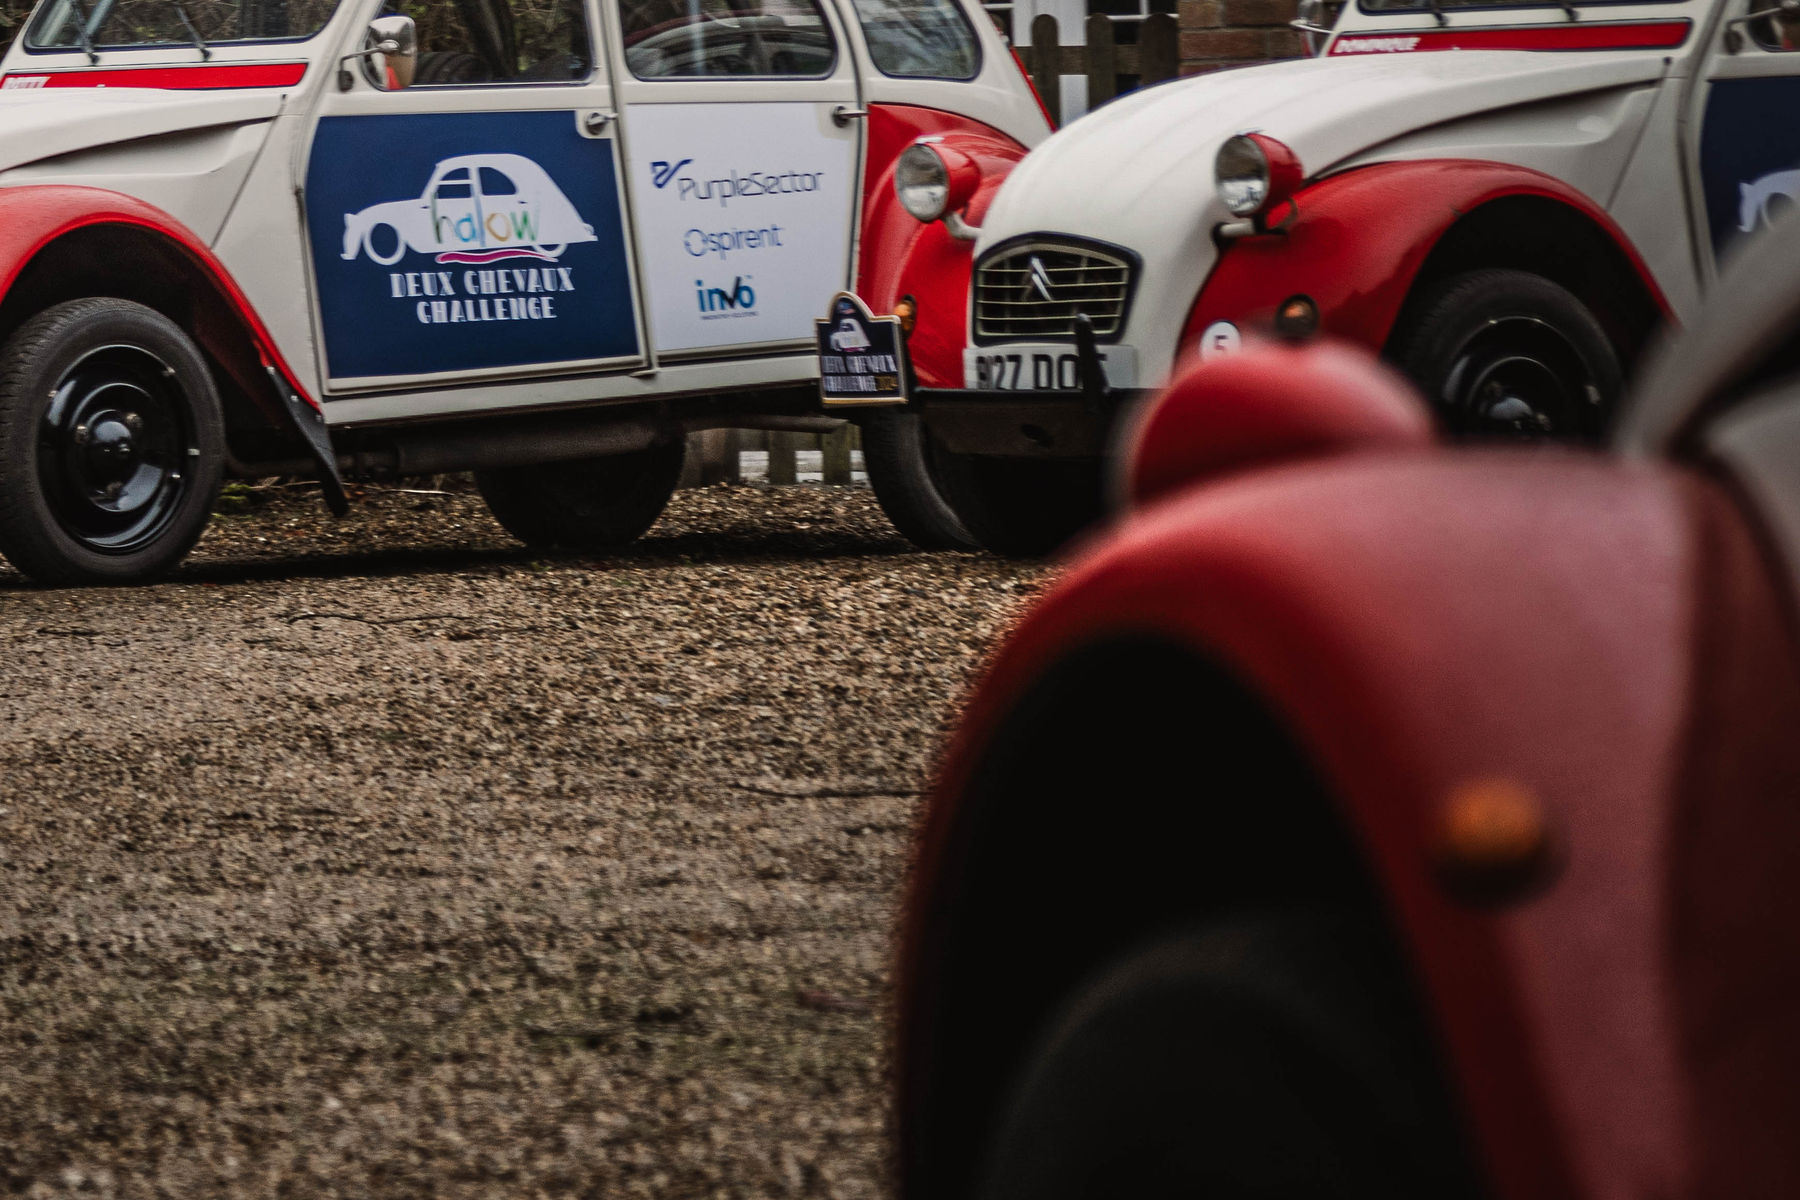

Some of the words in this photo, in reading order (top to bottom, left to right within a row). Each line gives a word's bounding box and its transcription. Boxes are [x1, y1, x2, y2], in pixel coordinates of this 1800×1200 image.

[677, 169, 825, 208] PurpleSector
[389, 272, 456, 298] DEUX
[463, 267, 576, 295] CHEVAUX
[416, 296, 558, 324] CHALLENGE
